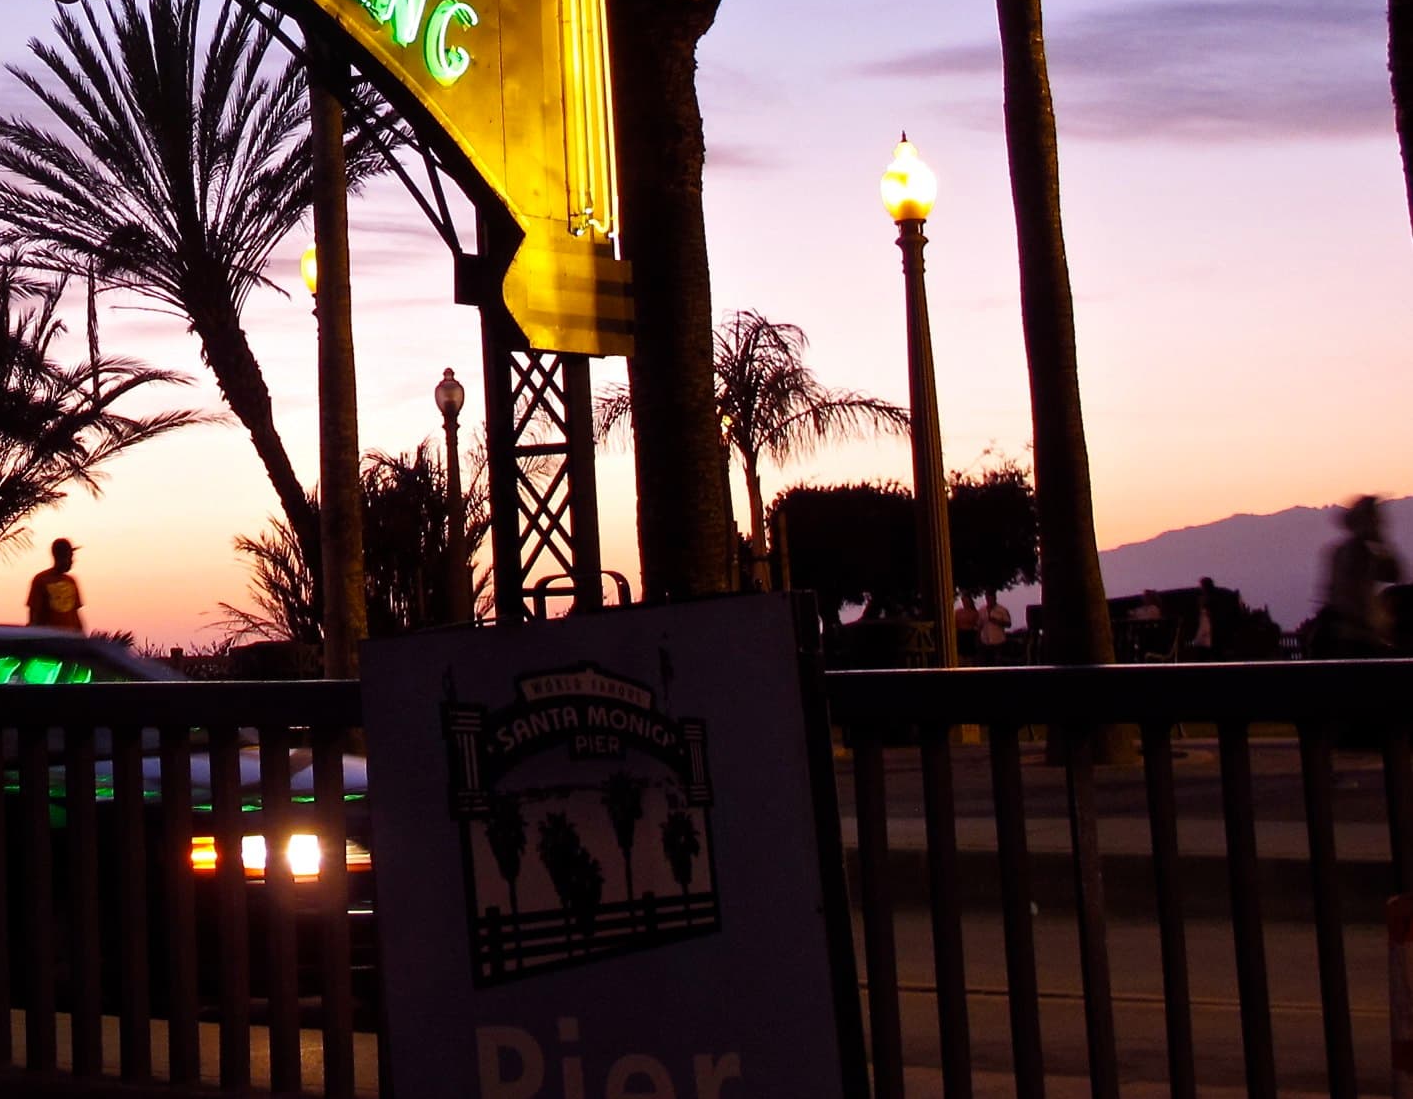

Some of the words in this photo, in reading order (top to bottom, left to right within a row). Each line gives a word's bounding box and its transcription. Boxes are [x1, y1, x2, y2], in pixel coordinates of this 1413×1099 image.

[496, 706, 580, 754] SANTA
[587, 706, 677, 748] MONICA
[574, 733, 621, 756] PIER
